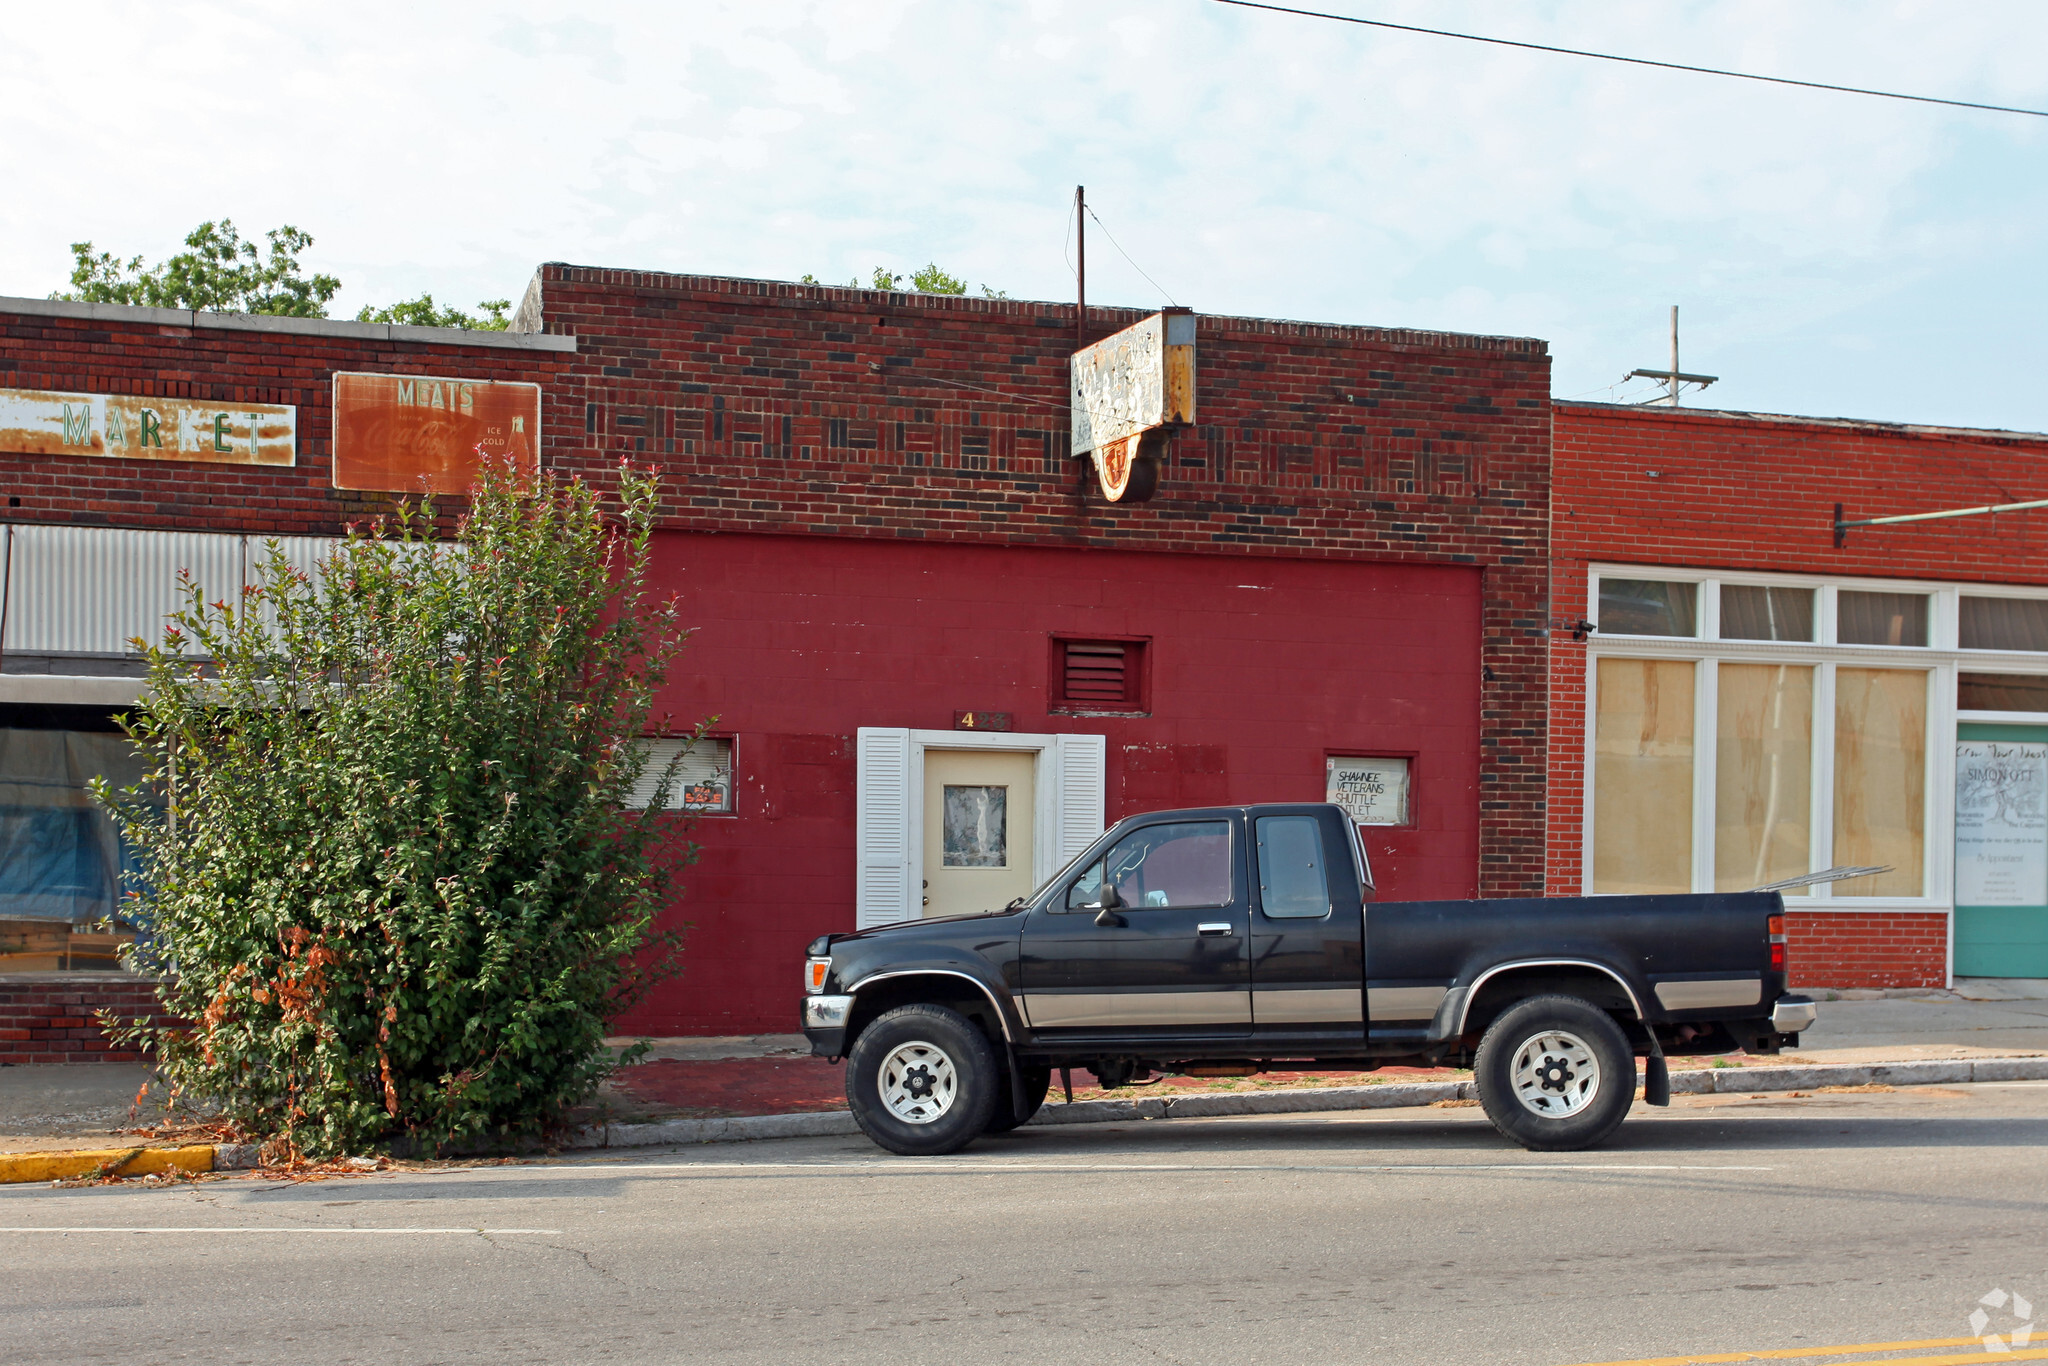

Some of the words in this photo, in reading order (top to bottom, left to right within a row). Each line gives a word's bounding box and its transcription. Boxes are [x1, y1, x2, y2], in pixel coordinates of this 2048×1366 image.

[397, 378, 474, 410] MEATS
[62, 403, 264, 454] MARKET
[487, 426, 502, 435] ICE
[482, 438, 505, 446] COLD
[961, 712, 1006, 728] 423
[1338, 771, 1381, 782] SHAWNEE
[1968, 768, 2007, 782] SIMON
[2009, 769, 2034, 782] OTT
[1336, 782, 1384, 794] VETERANS
[1335, 793, 1377, 805] SHUTTLE
[1341, 805, 1371, 815] TLET
